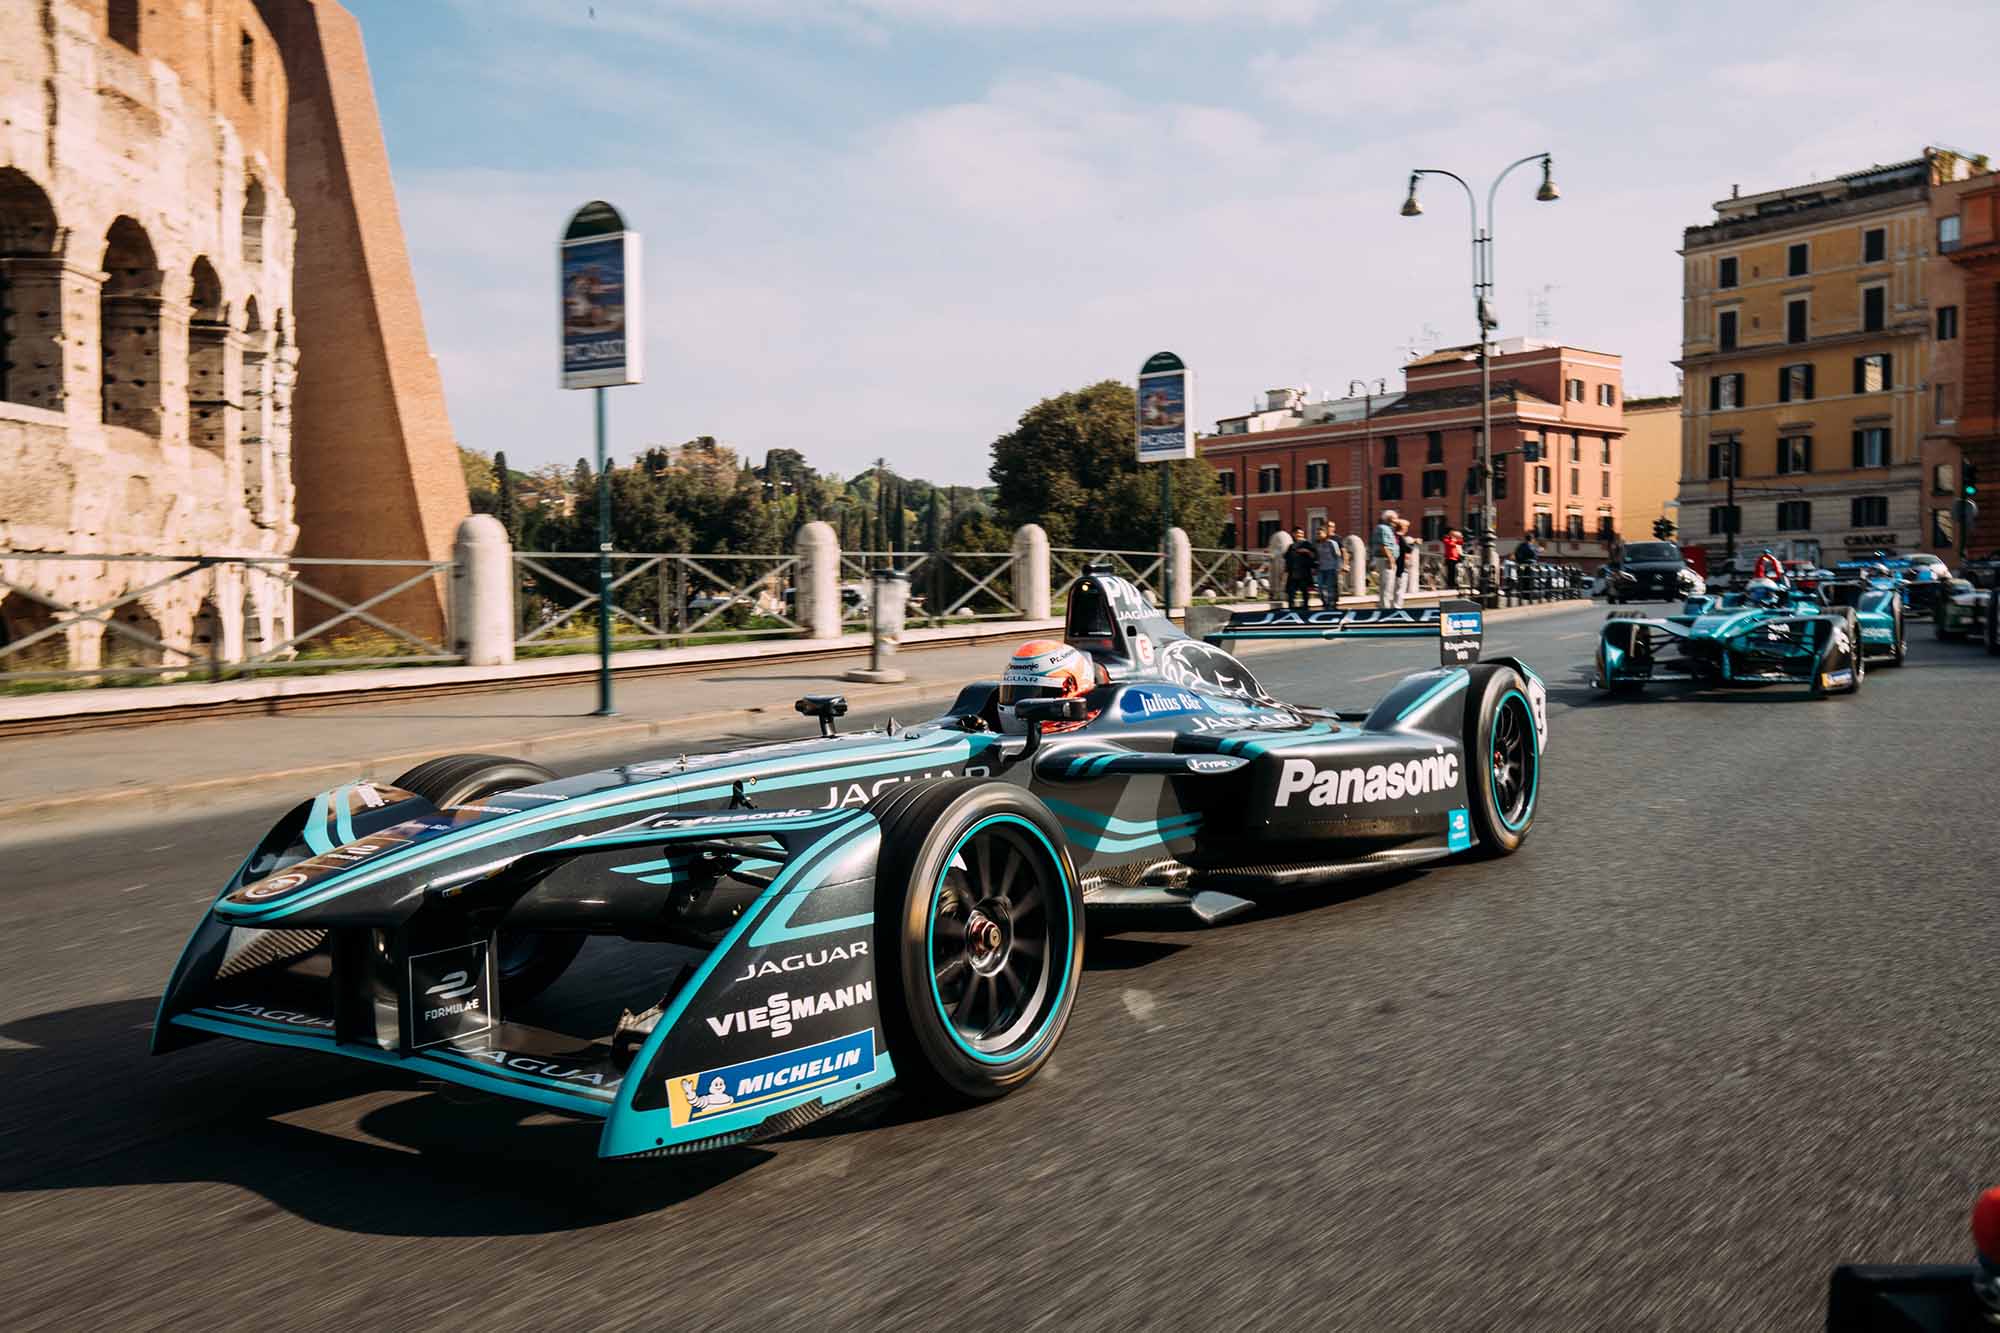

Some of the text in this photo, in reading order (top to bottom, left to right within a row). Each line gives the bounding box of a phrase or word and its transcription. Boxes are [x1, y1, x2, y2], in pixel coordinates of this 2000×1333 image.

[1119, 609, 1162, 620] JAGUAR
[1139, 694, 1182, 716] Julius
[1274, 743, 1459, 808] Panasonic
[651, 808, 814, 828] Panasonic
[735, 940, 869, 983] JAGUAR
[215, 1003, 336, 1027] JAGUA
[705, 980, 873, 1039] VIESSMANN
[736, 1047, 862, 1097] MICHELIN
